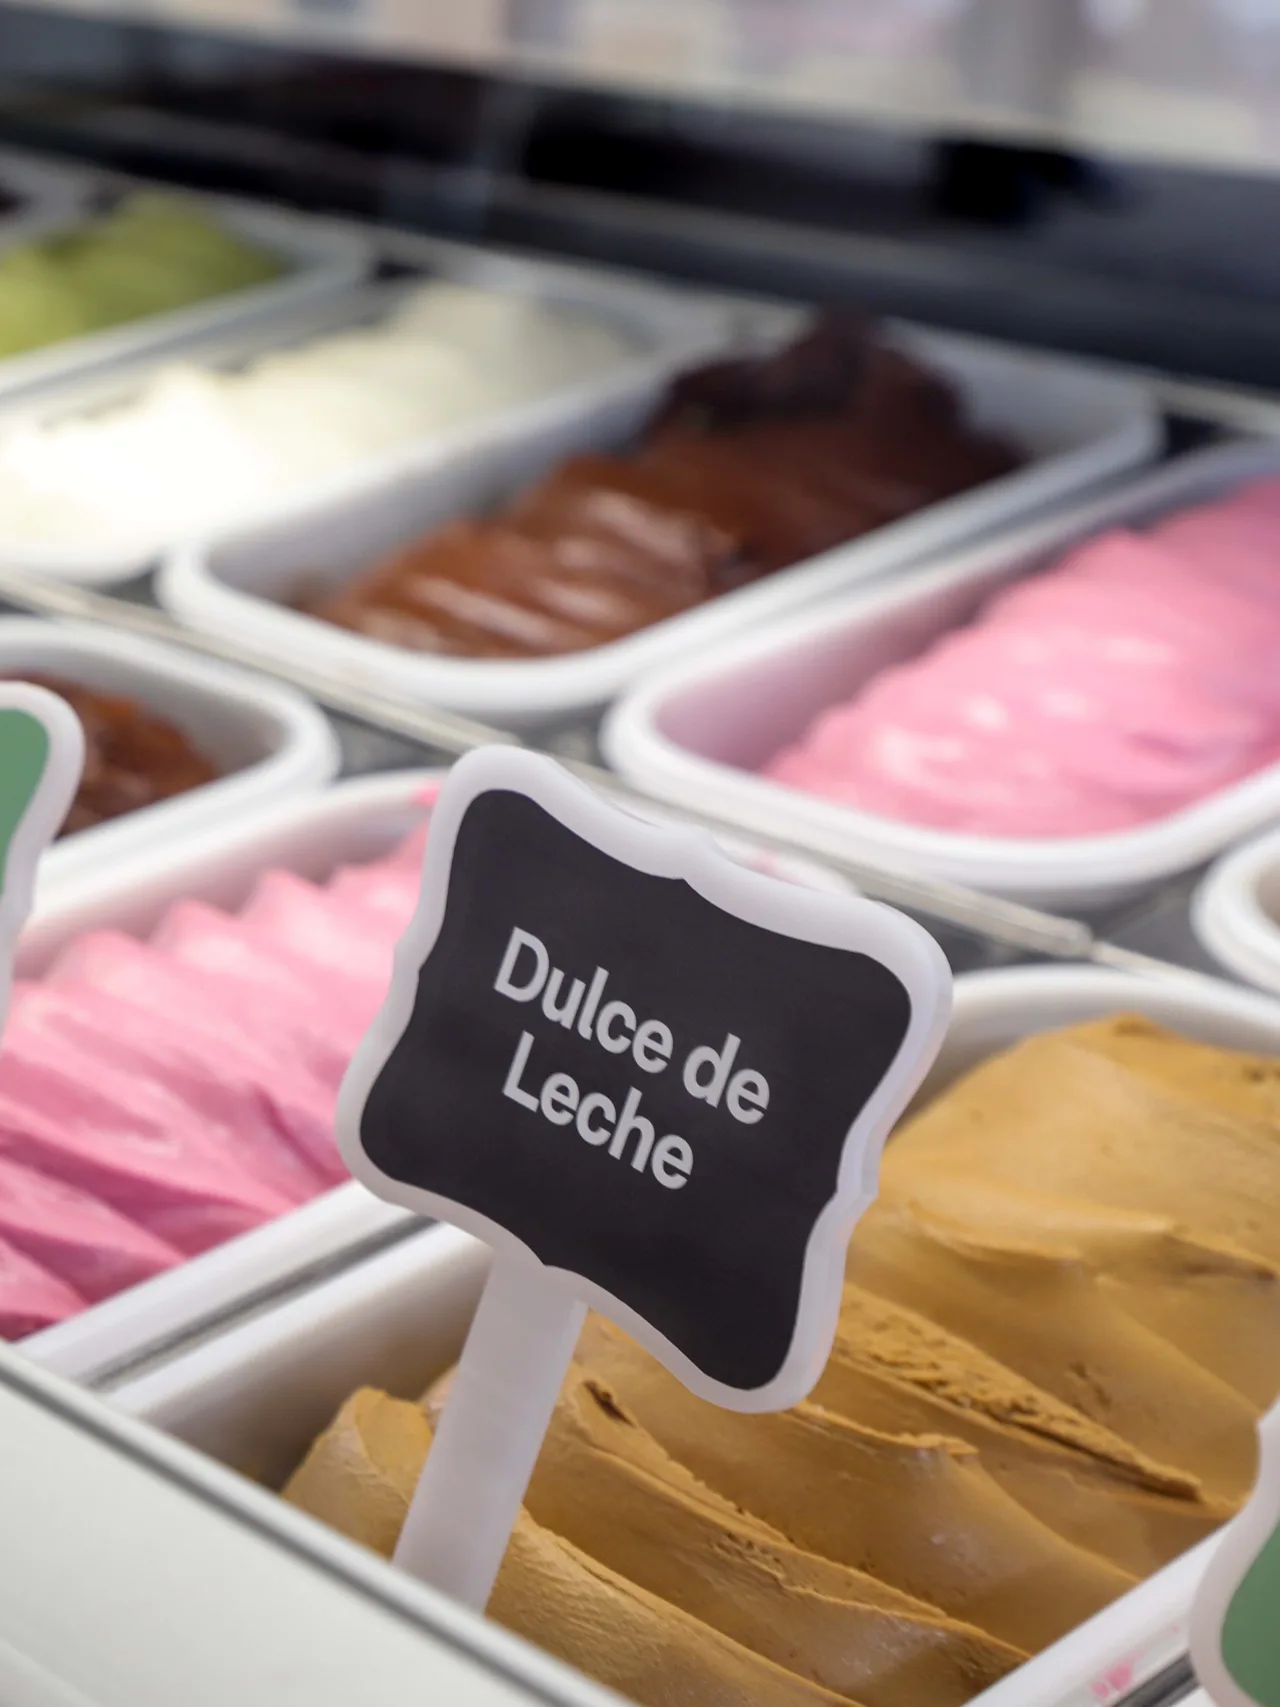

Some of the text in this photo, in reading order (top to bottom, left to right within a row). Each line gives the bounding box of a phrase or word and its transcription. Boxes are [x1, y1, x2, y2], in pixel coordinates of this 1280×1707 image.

[494, 926, 770, 1124] Dulce de
[502, 1031, 694, 1189] Leche
